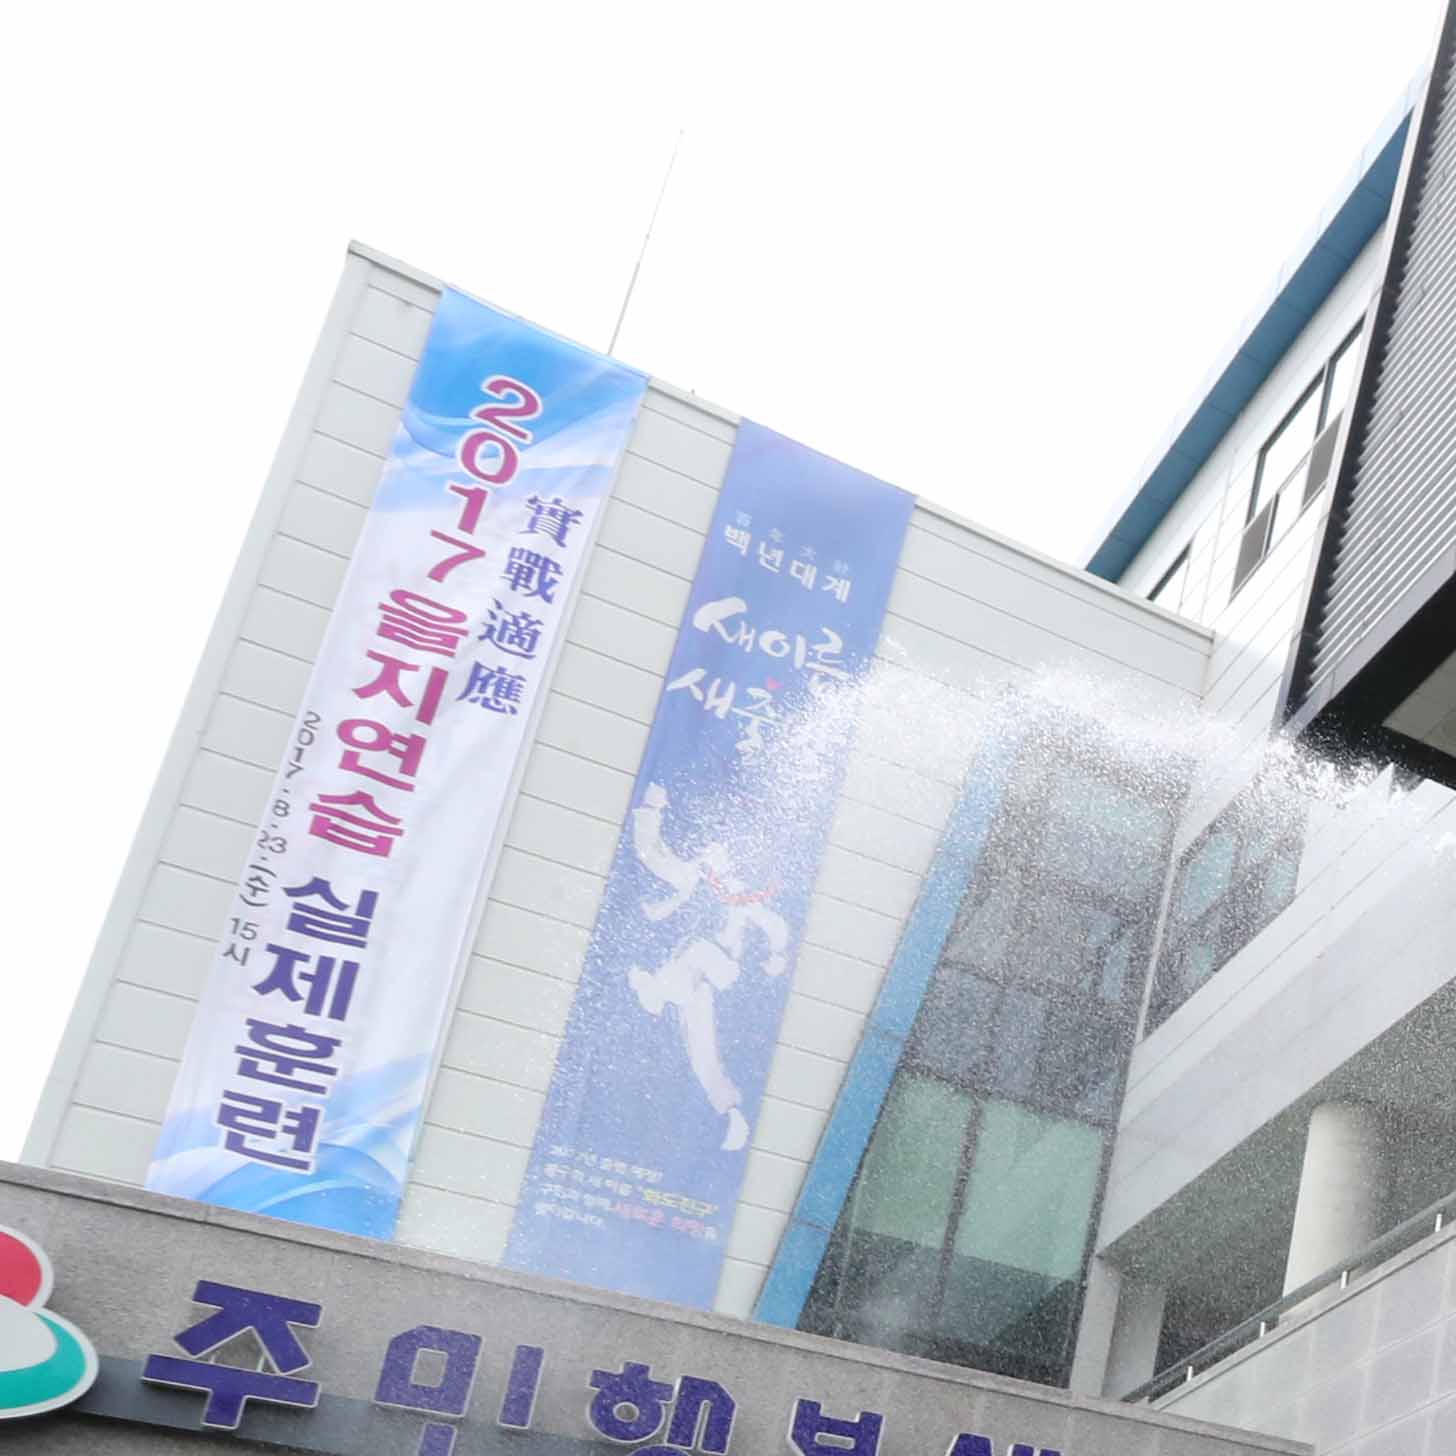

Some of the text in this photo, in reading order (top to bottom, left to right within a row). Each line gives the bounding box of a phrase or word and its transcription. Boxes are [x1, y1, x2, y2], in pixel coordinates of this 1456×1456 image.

[455, 495, 584, 716] 實戰適應
[724, 524, 851, 603] 백년대계
[216, 876, 379, 1172] 실제훈련
